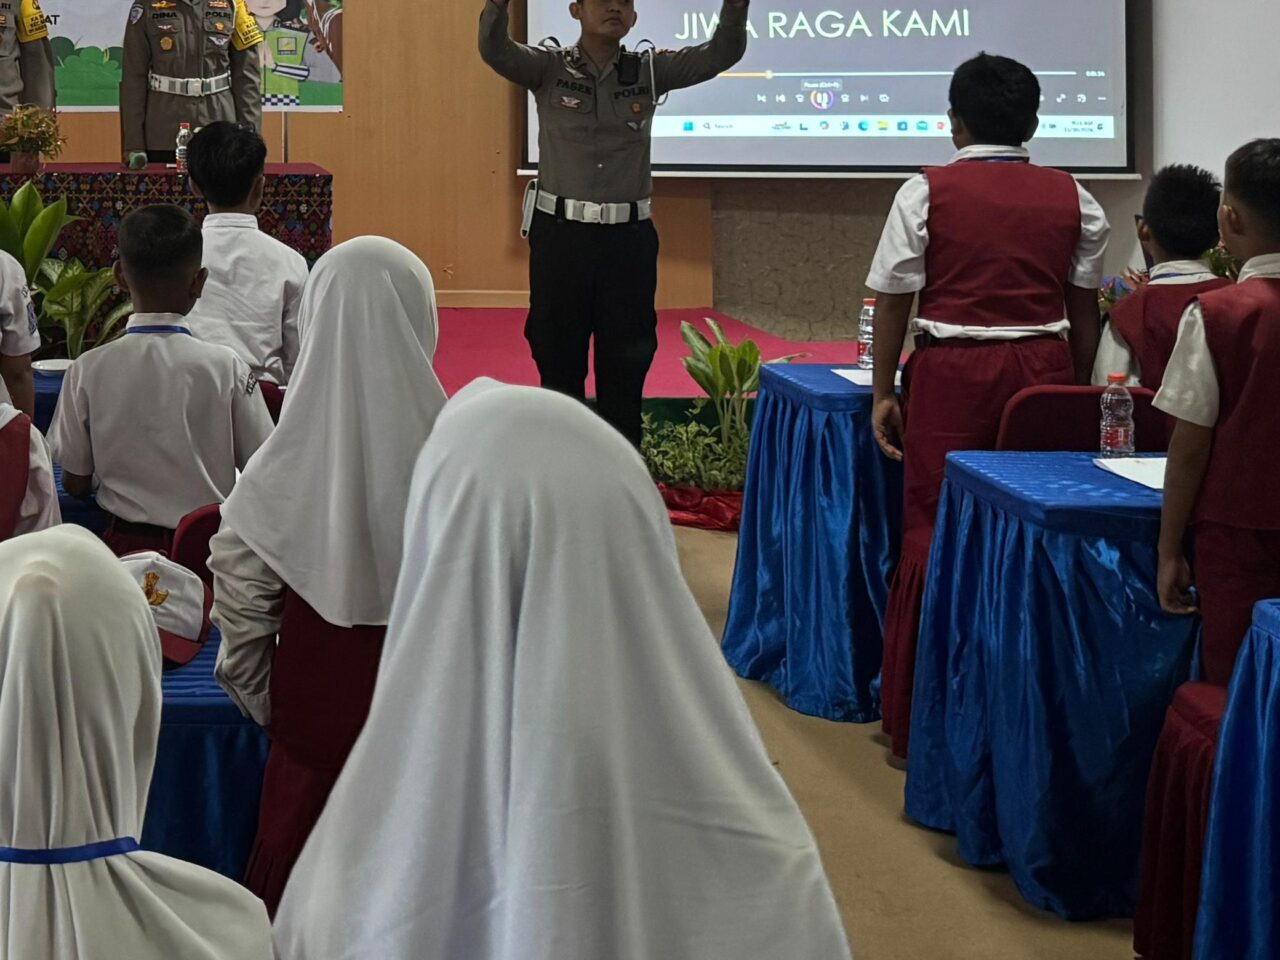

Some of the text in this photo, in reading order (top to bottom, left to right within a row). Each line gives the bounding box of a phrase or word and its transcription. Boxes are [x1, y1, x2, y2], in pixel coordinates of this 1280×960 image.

[152, 12, 178, 20] DINA
[768, 9, 873, 39] RAGA
[882, 8, 970, 37] KAMI
